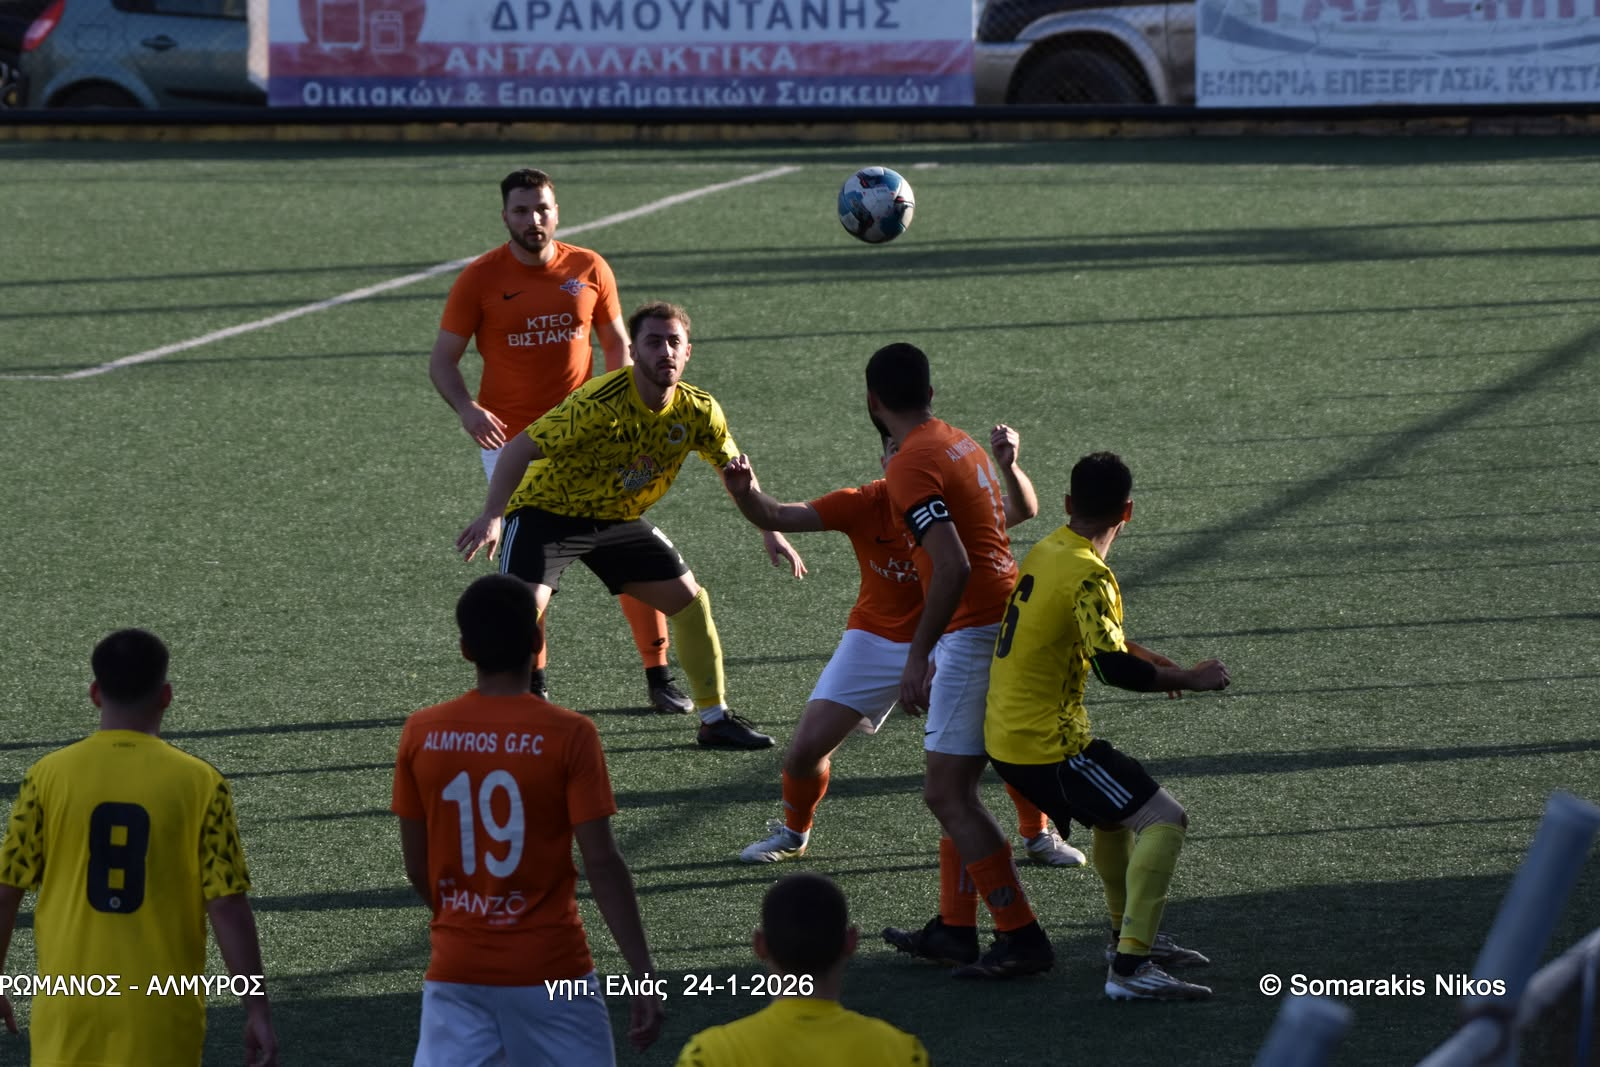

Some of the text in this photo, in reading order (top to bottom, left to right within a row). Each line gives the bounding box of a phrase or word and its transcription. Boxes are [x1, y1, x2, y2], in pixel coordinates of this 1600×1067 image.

[491, 0, 900, 31] ΔΡΑΜΟΥΝΤΑΝΗΣ
[445, 47, 798, 71] ΑΝΤΑΛΛΑΚΤΙΚΑ
[302, 78, 940, 108] Οικιακών & Επαγγελματικών Συσκευών
[507, 325, 585, 346] ΒΙΣΤΑΚΗΣ
[526, 313, 573, 330] ΚΤΕΟ
[996, 574, 1034, 658] 6
[424, 731, 545, 755] ALMYROS G.F.C
[442, 769, 525, 878] 19
[86, 801, 150, 914] 8
